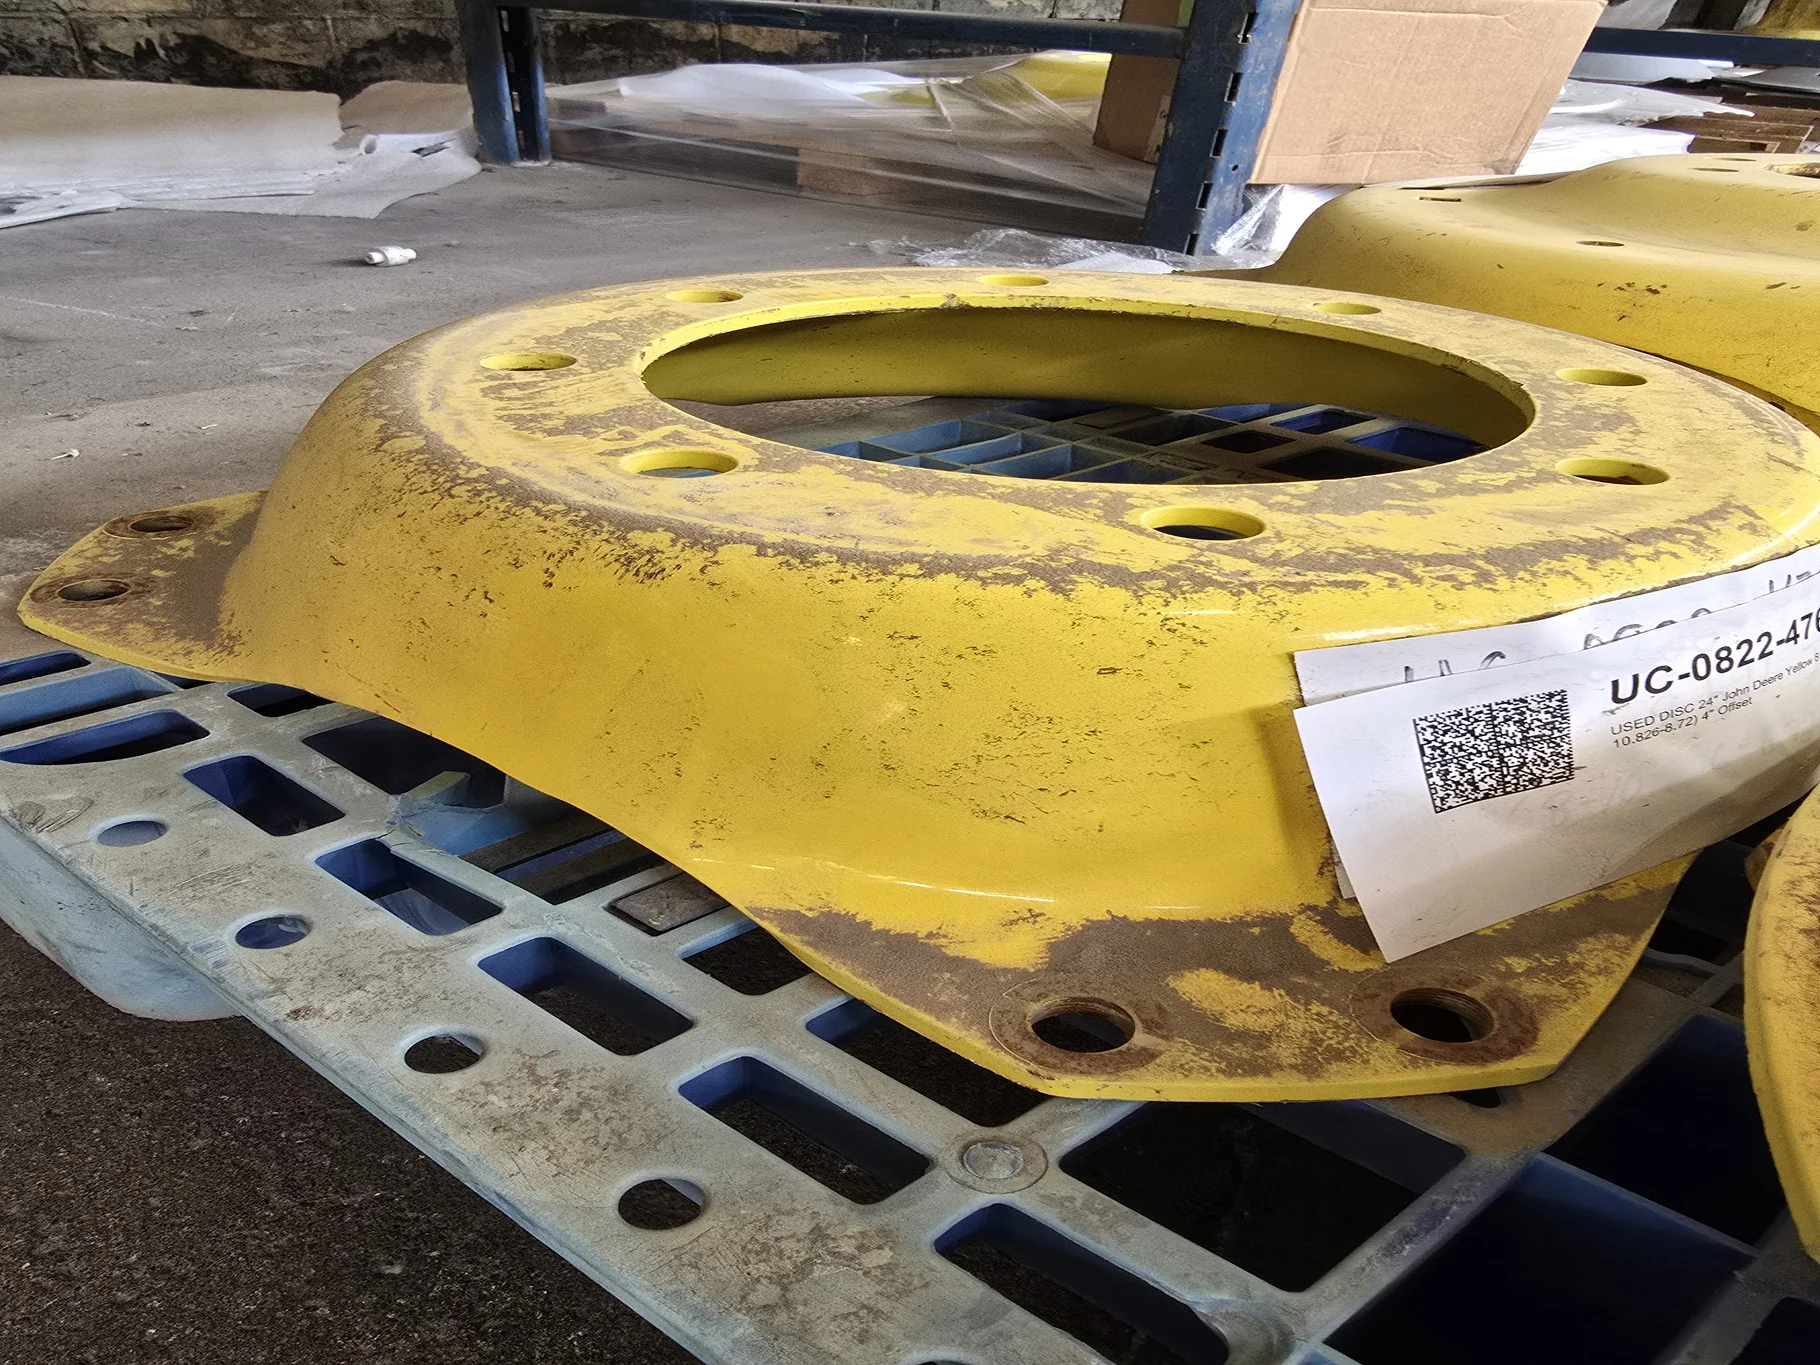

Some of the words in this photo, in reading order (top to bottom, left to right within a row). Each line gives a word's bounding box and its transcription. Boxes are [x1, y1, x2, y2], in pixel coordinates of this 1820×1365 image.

[1611, 715, 1655, 735] USED
[1659, 703, 1695, 722] DISC
[1698, 695, 1718, 710] 24"
[1722, 685, 1750, 702] John
[1753, 671, 1784, 690] Deere
[1785, 657, 1813, 676] Yellow
[1612, 715, 1698, 748] 10.826-8.72)
[1702, 709, 1715, 721] 4"
[1717, 697, 1753, 715] Offset
